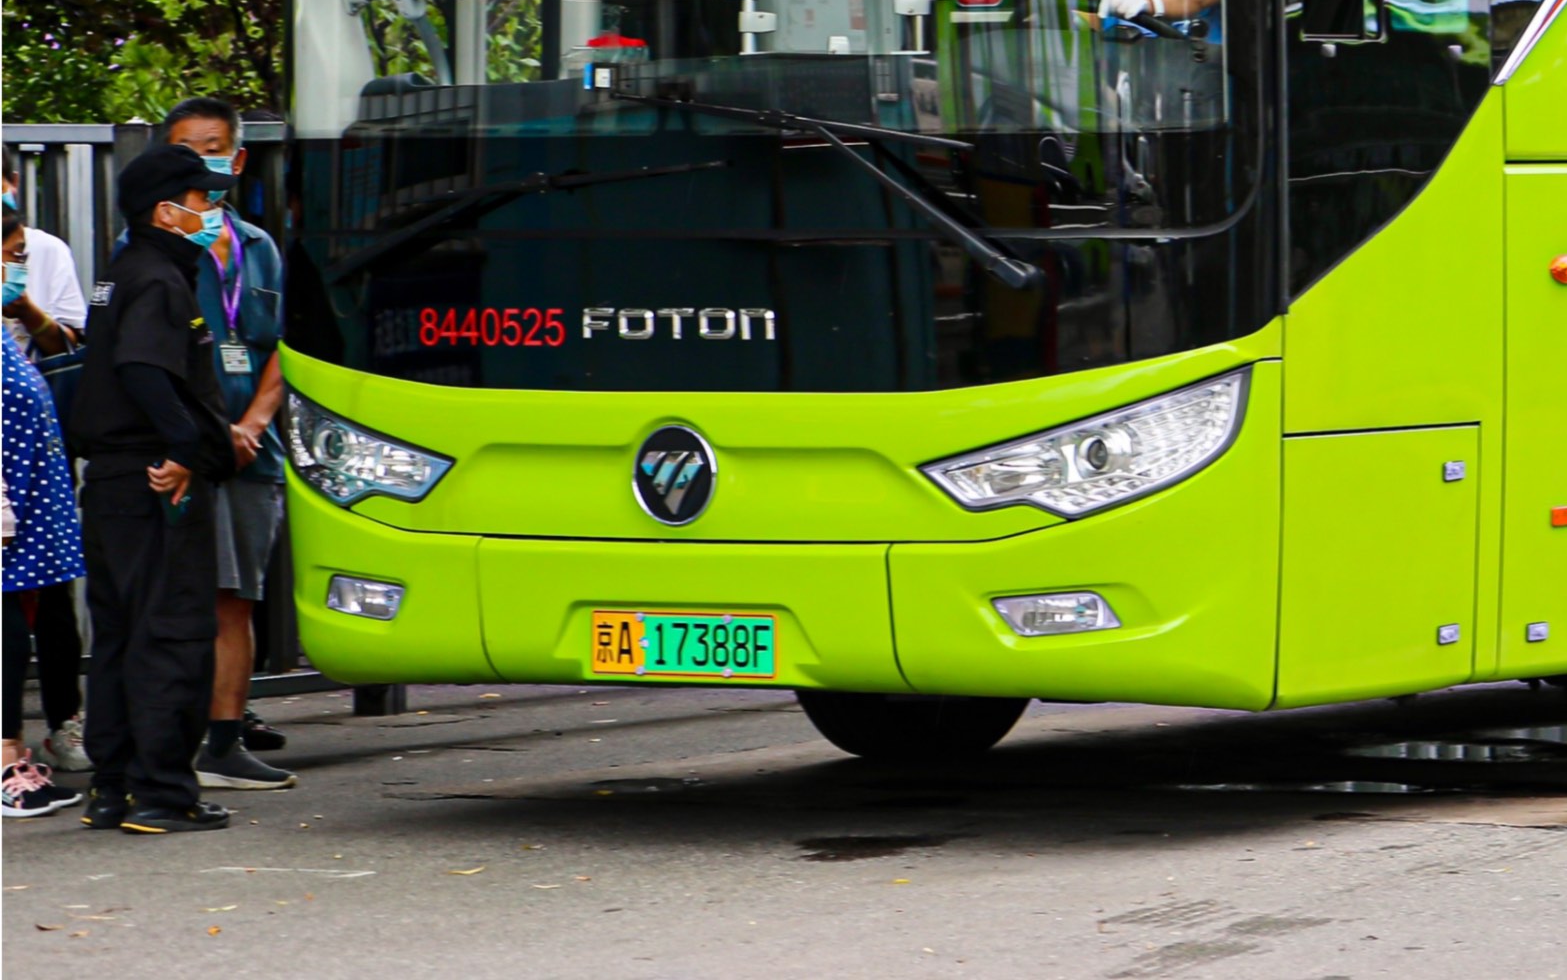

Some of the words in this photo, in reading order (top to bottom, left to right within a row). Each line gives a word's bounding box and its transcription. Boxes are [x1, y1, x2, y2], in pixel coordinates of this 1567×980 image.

[418, 307, 567, 347] 8440525
[581, 307, 775, 341] FOTON
[596, 621, 634, 665] 京A
[654, 622, 771, 668] 17388F
